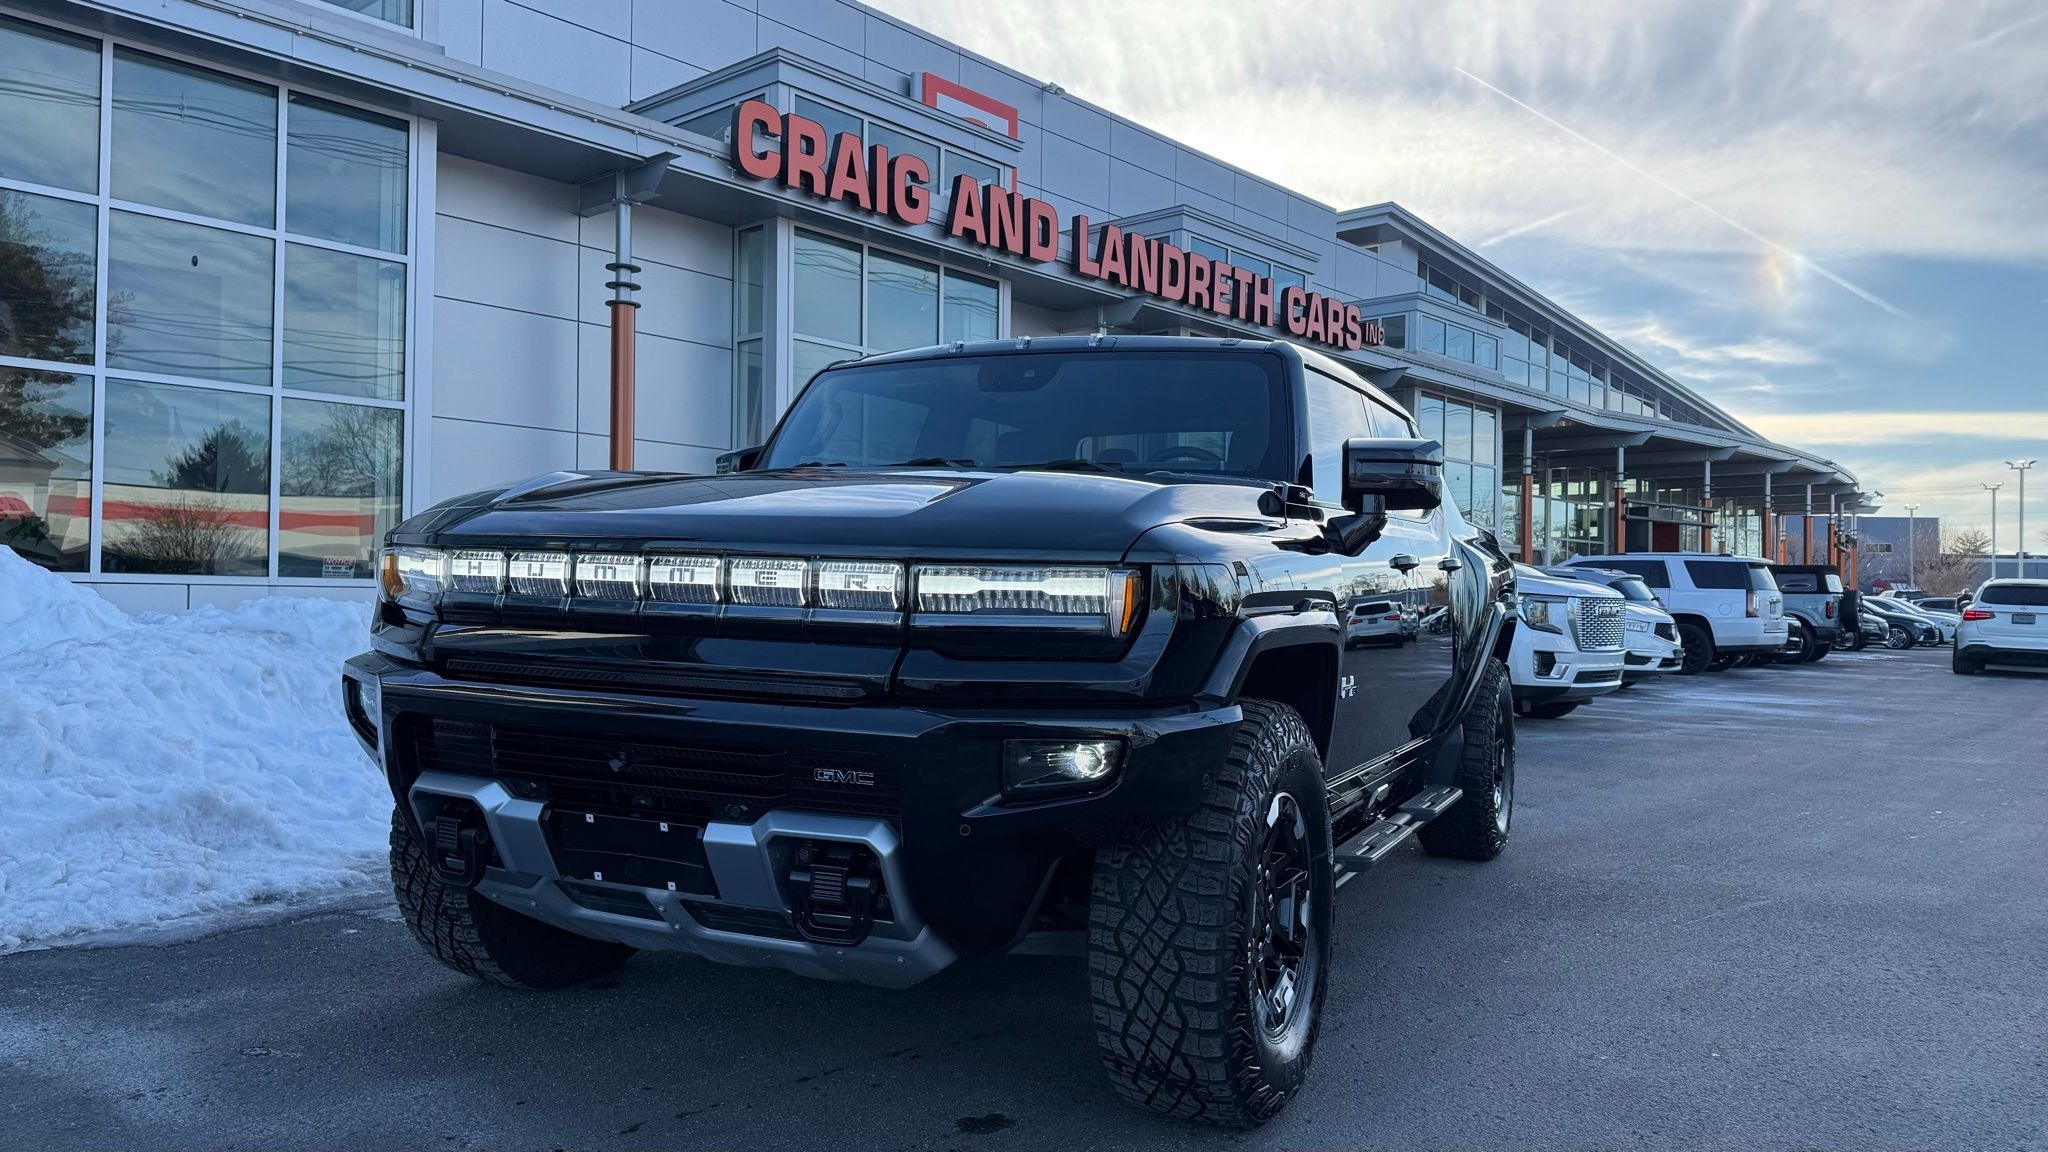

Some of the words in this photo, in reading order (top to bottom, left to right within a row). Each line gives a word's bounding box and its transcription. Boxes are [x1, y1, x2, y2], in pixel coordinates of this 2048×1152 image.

[735, 100, 931, 225] CRAIG
[948, 173, 1059, 262] AND
[1073, 214, 1275, 327] LANDRETH
[1284, 286, 1363, 351] CARS
[814, 768, 875, 786] GMC
